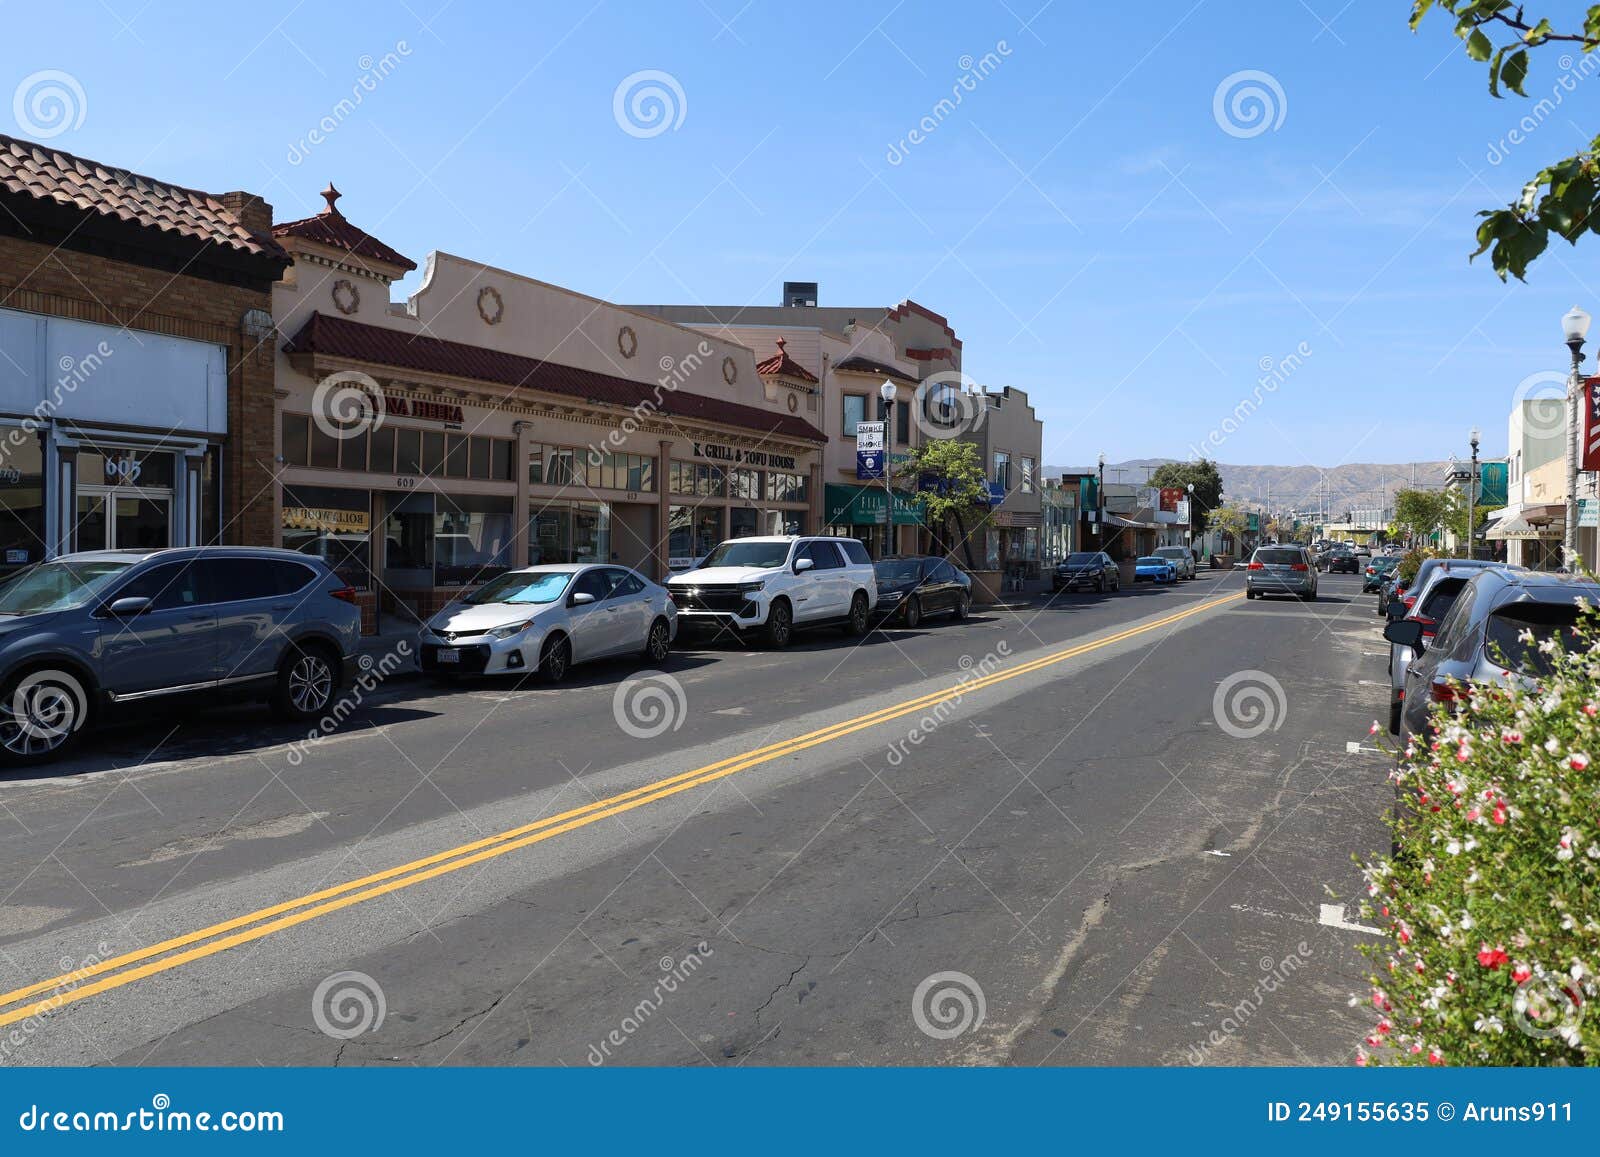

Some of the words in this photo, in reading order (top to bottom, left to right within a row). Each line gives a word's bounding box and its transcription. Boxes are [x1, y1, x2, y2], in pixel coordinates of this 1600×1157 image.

[705, 444, 734, 461] GRILL
[744, 451, 767, 466] TOFU
[768, 454, 795, 469] HOUSE
[105, 457, 142, 481] 605
[397, 478, 415, 488] 609
